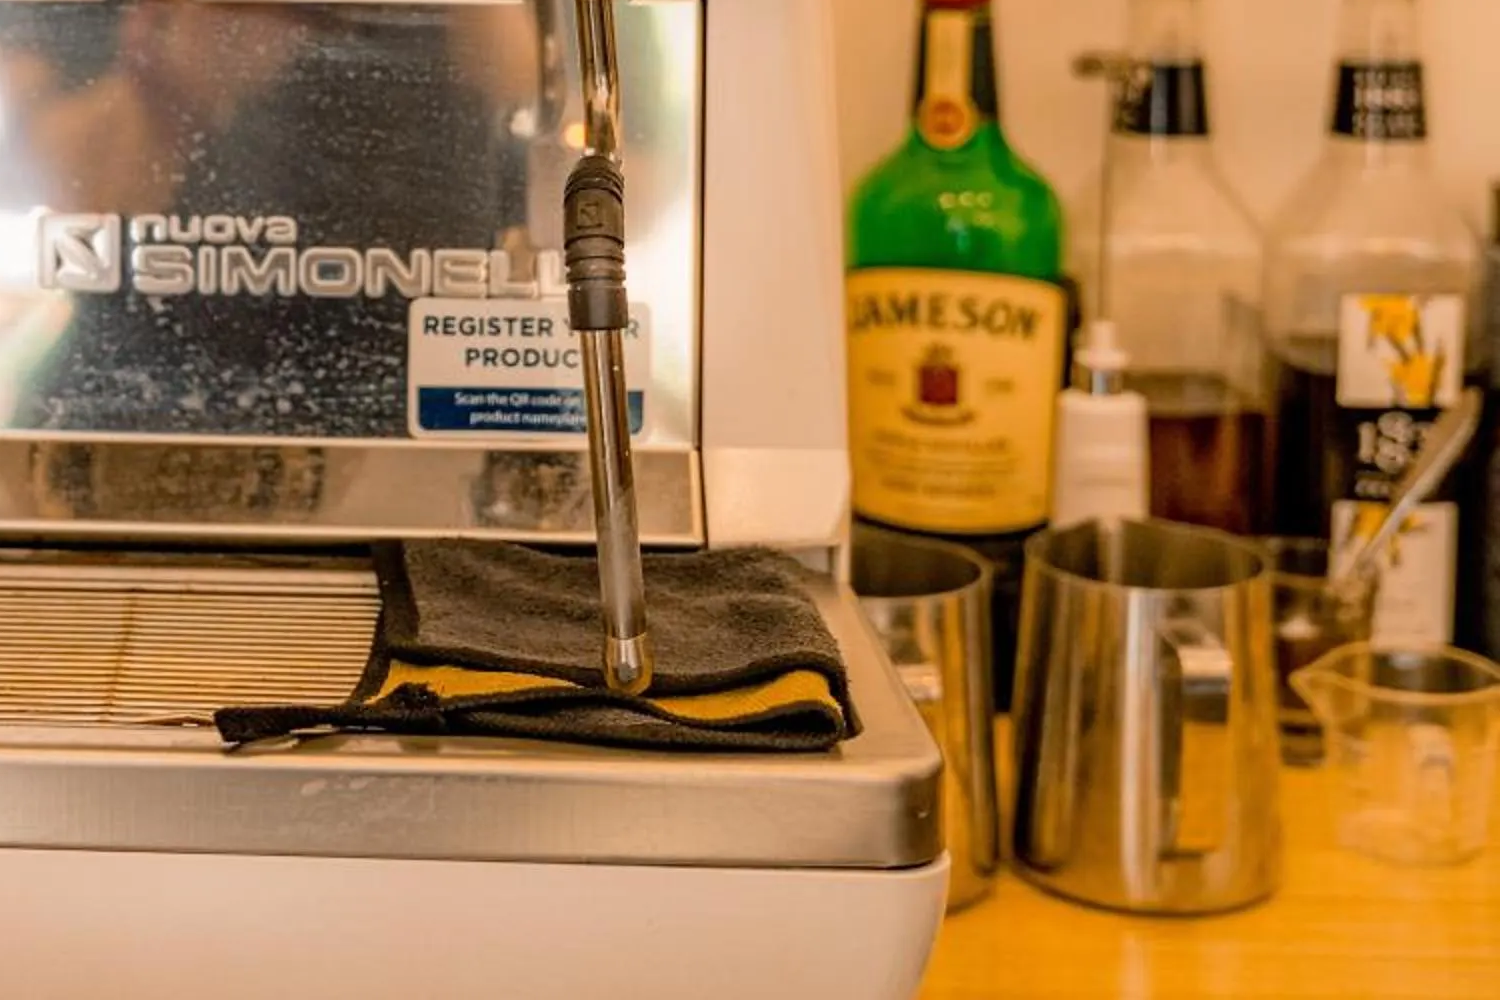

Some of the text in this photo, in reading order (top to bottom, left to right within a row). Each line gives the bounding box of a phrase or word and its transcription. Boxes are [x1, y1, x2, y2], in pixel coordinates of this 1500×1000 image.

[132, 213, 298, 244] nuova
[132, 245, 569, 299] SIMONELL
[423, 315, 554, 337] REGISTER
[853, 291, 1043, 341] JAMESON
[465, 347, 580, 368] PRODUC
[454, 391, 484, 407] Scan
[486, 391, 508, 406] the
[469, 409, 520, 425] product
